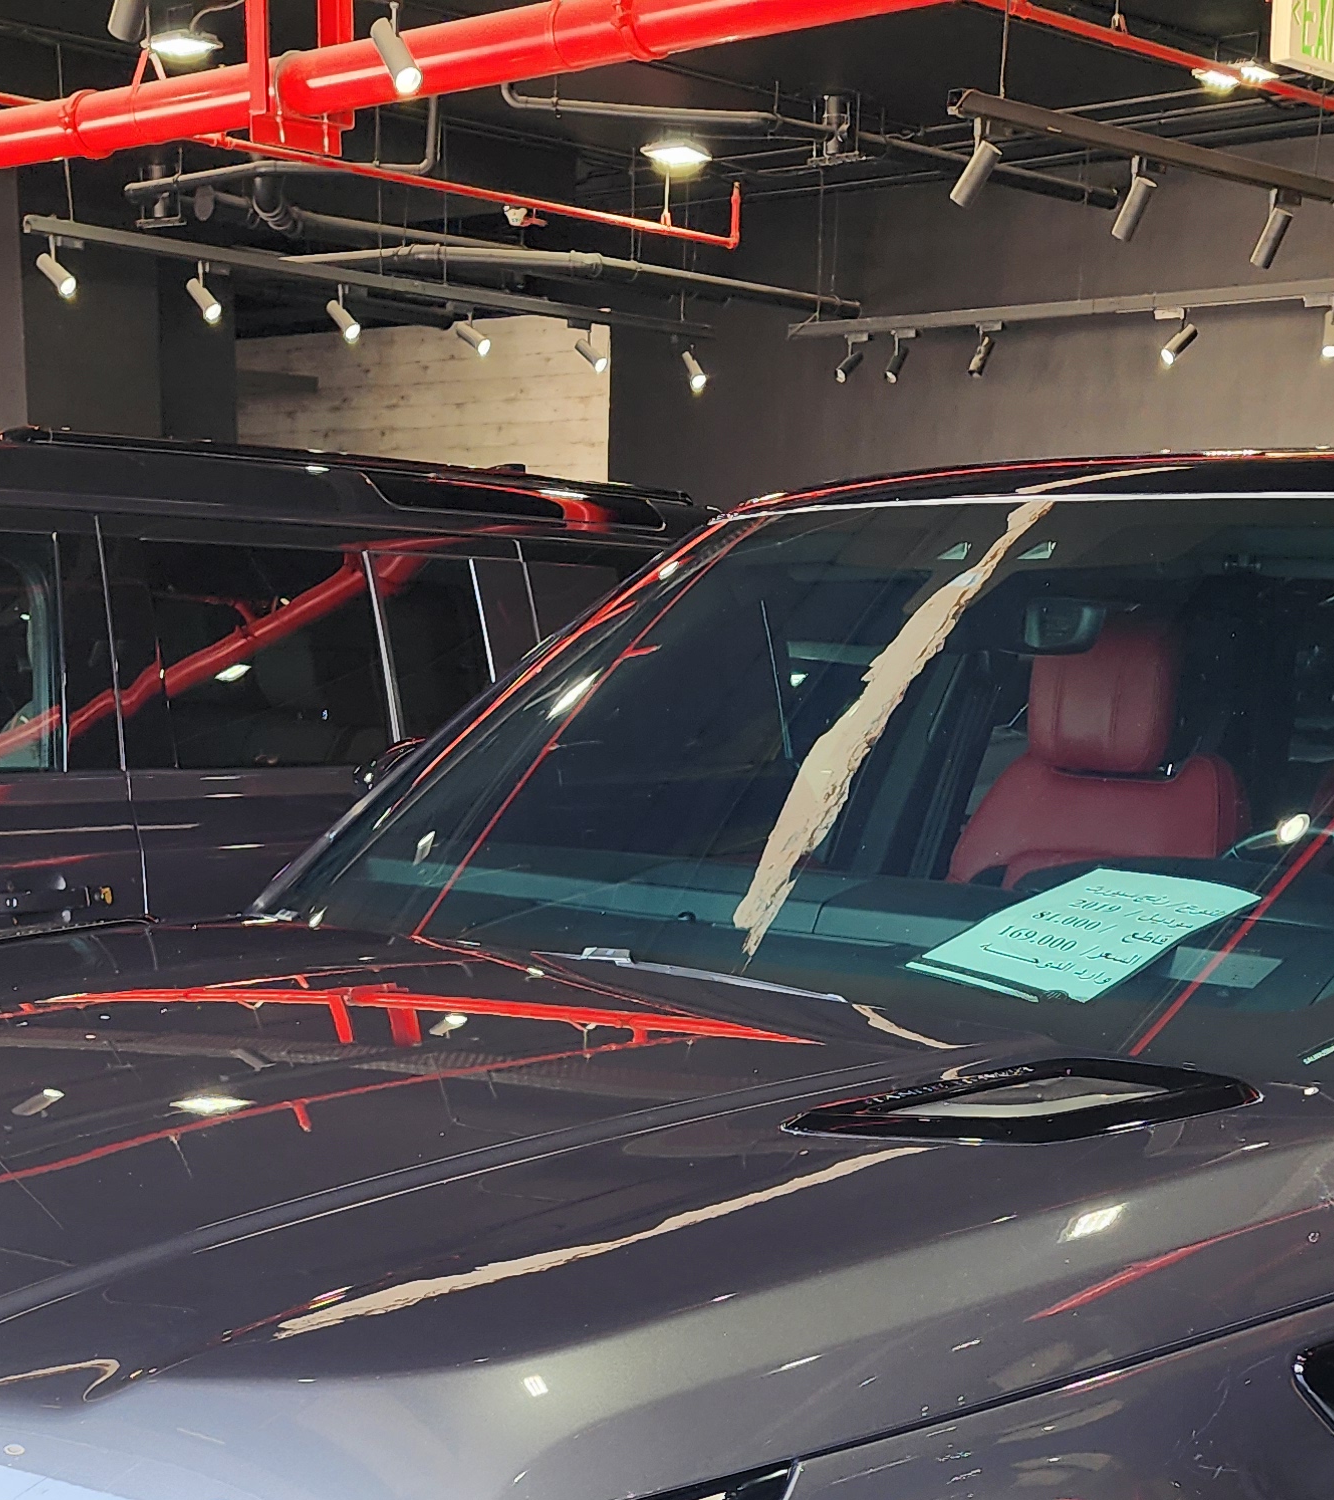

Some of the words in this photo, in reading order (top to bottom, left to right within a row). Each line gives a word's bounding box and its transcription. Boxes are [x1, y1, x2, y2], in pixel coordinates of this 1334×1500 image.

[1068, 899, 1123, 913] 2019
[1032, 910, 1102, 931] 81.000
[998, 925, 1078, 952] 169.000
